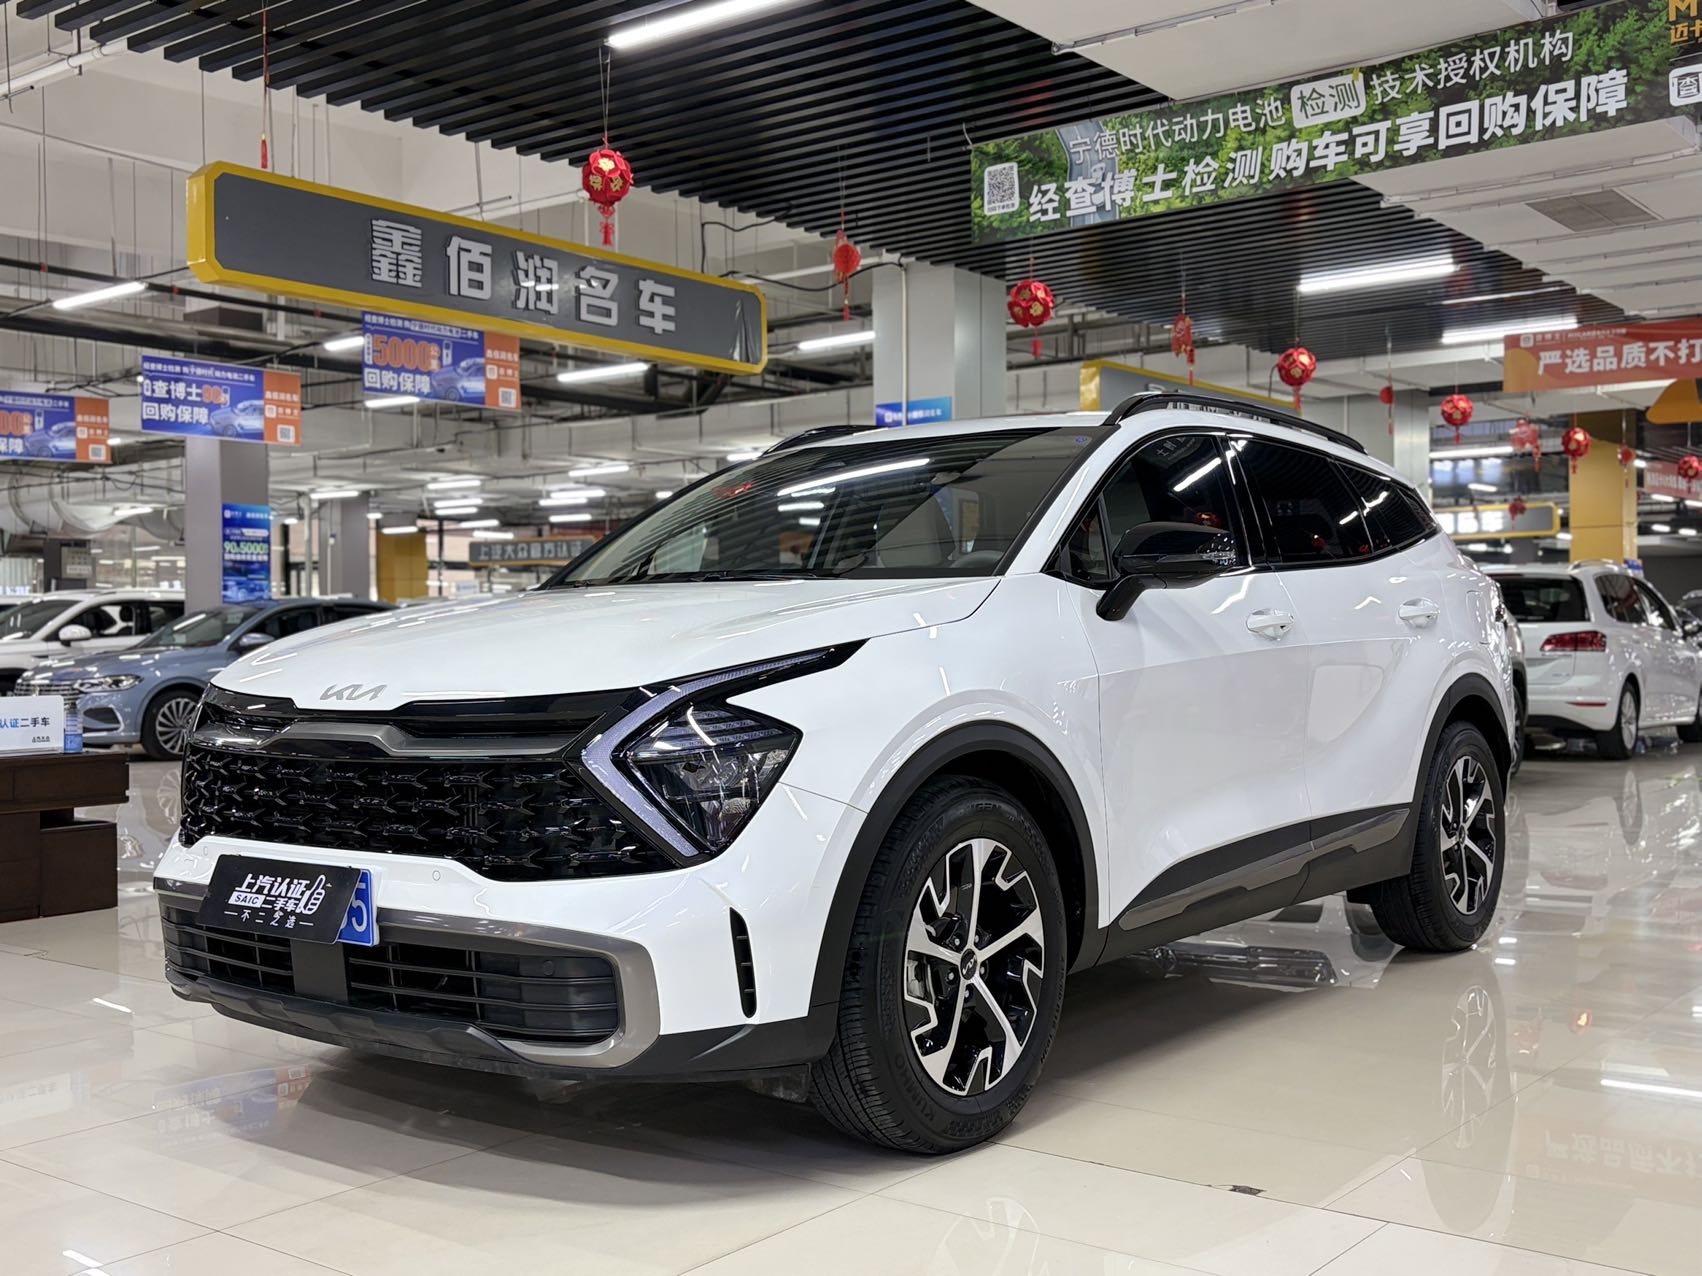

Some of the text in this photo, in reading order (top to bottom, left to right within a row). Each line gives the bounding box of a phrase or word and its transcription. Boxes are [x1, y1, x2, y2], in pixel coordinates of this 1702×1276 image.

[1068, 29, 1574, 165] 宁德时代动力电池 检测 技术授权机构
[371, 218, 676, 335] 鑫佰润名车
[364, 367, 431, 395] 回购保障
[142, 401, 209, 425] 回购保障
[235, 873, 310, 898] 上汽认证
[234, 893, 300, 912] SAIC 二手车
